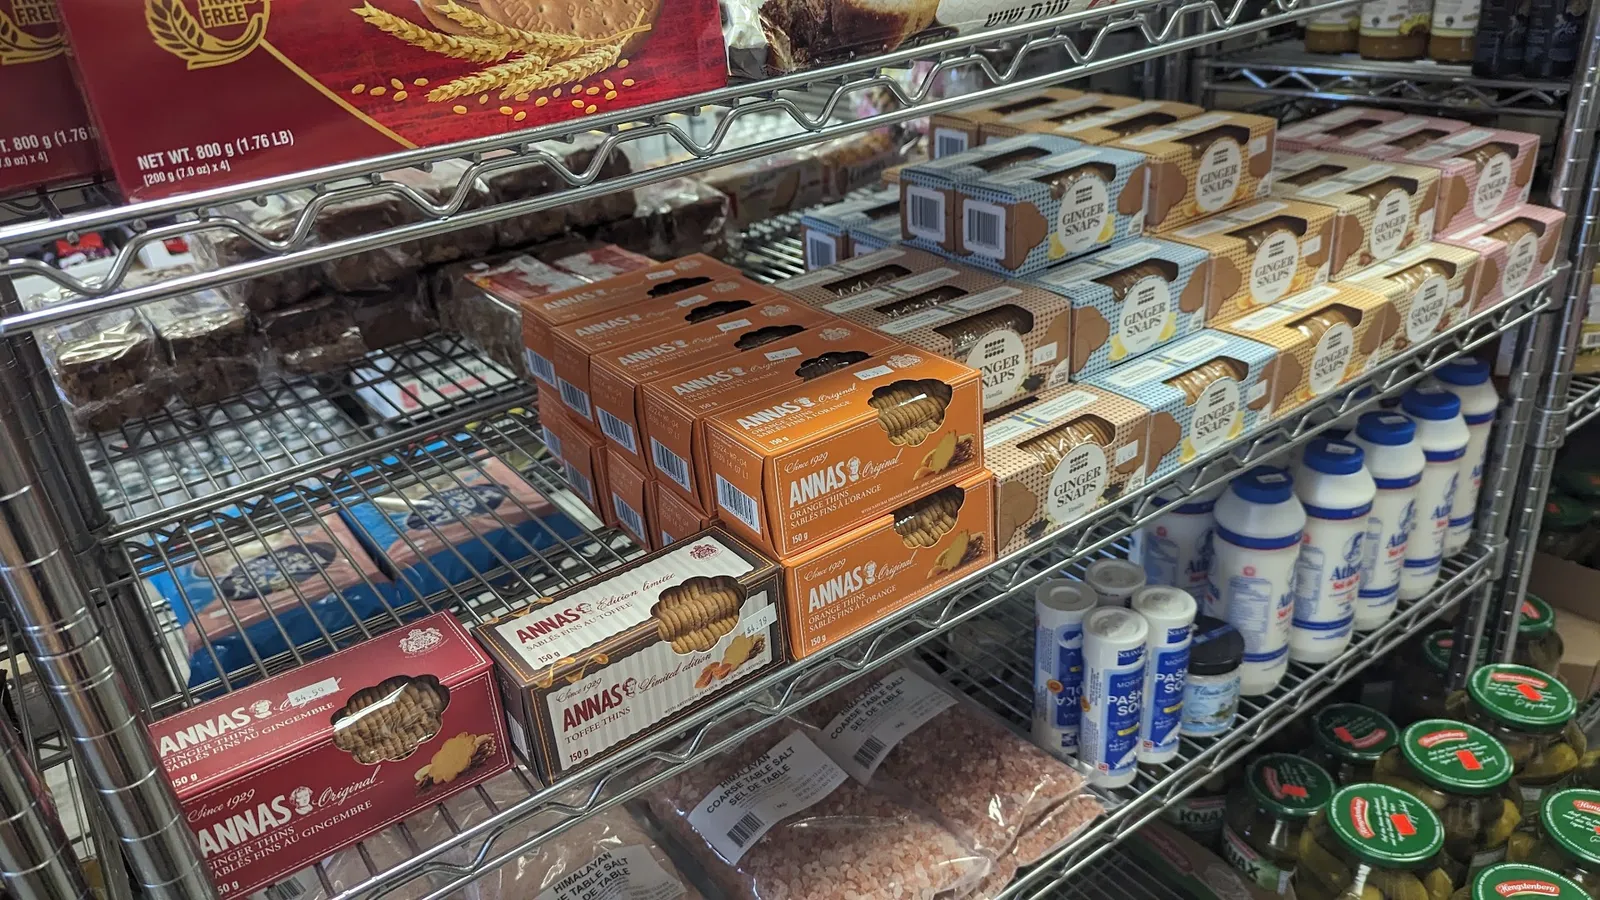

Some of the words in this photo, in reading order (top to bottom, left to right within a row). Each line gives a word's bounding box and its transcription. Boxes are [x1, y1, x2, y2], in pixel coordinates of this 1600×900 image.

[201, 5, 246, 27] FREE
[0, 140, 11, 153] T.
[13, 134, 39, 151] 800
[42, 135, 52, 149] g
[54, 127, 88, 147] (1.76
[137, 153, 165, 170] NET
[167, 148, 194, 165] WT.
[197, 142, 222, 160] 800
[225, 143, 234, 157] g
[236, 134, 270, 155] (1.76
[271, 129, 295, 146] LB)
[14, 155, 28, 166] oz)
[30, 154, 37, 163] x
[143, 172, 166, 187] [200
[168, 173, 175, 182] g
[176, 166, 194, 180] (7.0
[196, 163, 211, 175] oz)
[212, 164, 219, 172] x
[1200, 164, 1238, 185] GINGER
[1062, 203, 1104, 225] GINGER
[1064, 216, 1101, 237] SNAPS
[1255, 255, 1294, 278] GINGER
[575, 316, 631, 337] ANNAS
[1124, 302, 1166, 327] GINGER
[1126, 315, 1162, 338] SNAPS
[618, 342, 677, 366] ANNAS
[979, 354, 1020, 377] INGER
[672, 370, 734, 396] ANNAS
[982, 368, 1016, 389] NAPS
[736, 401, 800, 430] ANNAS
[815, 383, 857, 404] Original
[1194, 402, 1236, 429] GINGER
[1196, 414, 1231, 440] SNAPS
[768, 438, 782, 446] 150
[784, 459, 809, 474] Since
[810, 451, 829, 468] 1929
[790, 461, 847, 508] ANNAS
[859, 448, 904, 480] Original
[1054, 466, 1102, 498] GINGER
[790, 500, 824, 520] ORANGE
[825, 489, 850, 505] THINS
[1056, 480, 1098, 509] SNAPS
[820, 504, 838, 518] FINS
[792, 533, 802, 544] 150
[803, 532, 809, 541] g
[808, 566, 863, 614] ANNAS
[875, 549, 918, 580] Original
[562, 624, 583, 637] FINS
[584, 618, 598, 627] AU
[599, 602, 634, 620] TOFFEE
[808, 606, 841, 625] ORANGE
[842, 593, 866, 609] THINS
[837, 607, 854, 620] FINS
[516, 607, 581, 644] ANNAS
[811, 636, 821, 646] 150
[821, 634, 827, 643] g
[538, 654, 553, 664] 150
[554, 651, 561, 659] g
[556, 687, 582, 703] Since
[583, 677, 603, 696] 1929
[563, 683, 624, 733] ANNAS
[637, 662, 683, 695] Limited
[682, 652, 712, 673] edition
[841, 680, 884, 716] HIMALAYAN
[1164, 680, 1185, 694] SO
[831, 709, 861, 740] COARSE
[861, 690, 886, 711] TABLE
[885, 676, 906, 693] SALT
[850, 716, 867, 732] SEL
[867, 707, 878, 718] DE
[879, 689, 904, 710] TABLE
[1117, 702, 1140, 716] SO
[161, 707, 251, 758] ANNAS
[212, 739, 241, 754] FINS
[244, 731, 260, 742] AU
[262, 702, 335, 734] GINGEMBRE
[565, 721, 602, 745] TOFFEE
[601, 706, 632, 725] THINS
[163, 743, 212, 767] GINGER
[216, 726, 255, 746] THINS
[569, 751, 583, 763] 150
[583, 749, 589, 759] g
[190, 773, 198, 781] g
[706, 781, 744, 814] COARSE
[743, 765, 773, 787] TABLE
[772, 746, 796, 769] SALT
[720, 752, 771, 788] HIMALAYAN
[729, 790, 749, 807] SEL
[749, 783, 761, 793] DE
[762, 764, 791, 788] TABLE
[187, 804, 224, 822] Since
[227, 788, 256, 810] 1929
[198, 795, 292, 859] ANNAS
[312, 765, 381, 806] Original
[214, 856, 252, 879] ABLÉS
[254, 842, 282, 861] FINS
[284, 834, 300, 848] AU
[302, 800, 373, 839] GINGEMBRE
[255, 826, 296, 849] THINS
[553, 852, 613, 894] HIMALAYAN
[569, 872, 604, 897] TABLE
[604, 857, 630, 871] SALT
[582, 889, 599, 900] DE
[598, 868, 632, 889] TABLE
[217, 883, 230, 894] 50
[232, 880, 239, 890] g
[1499, 882, 1556, 894] Hengstenberg
